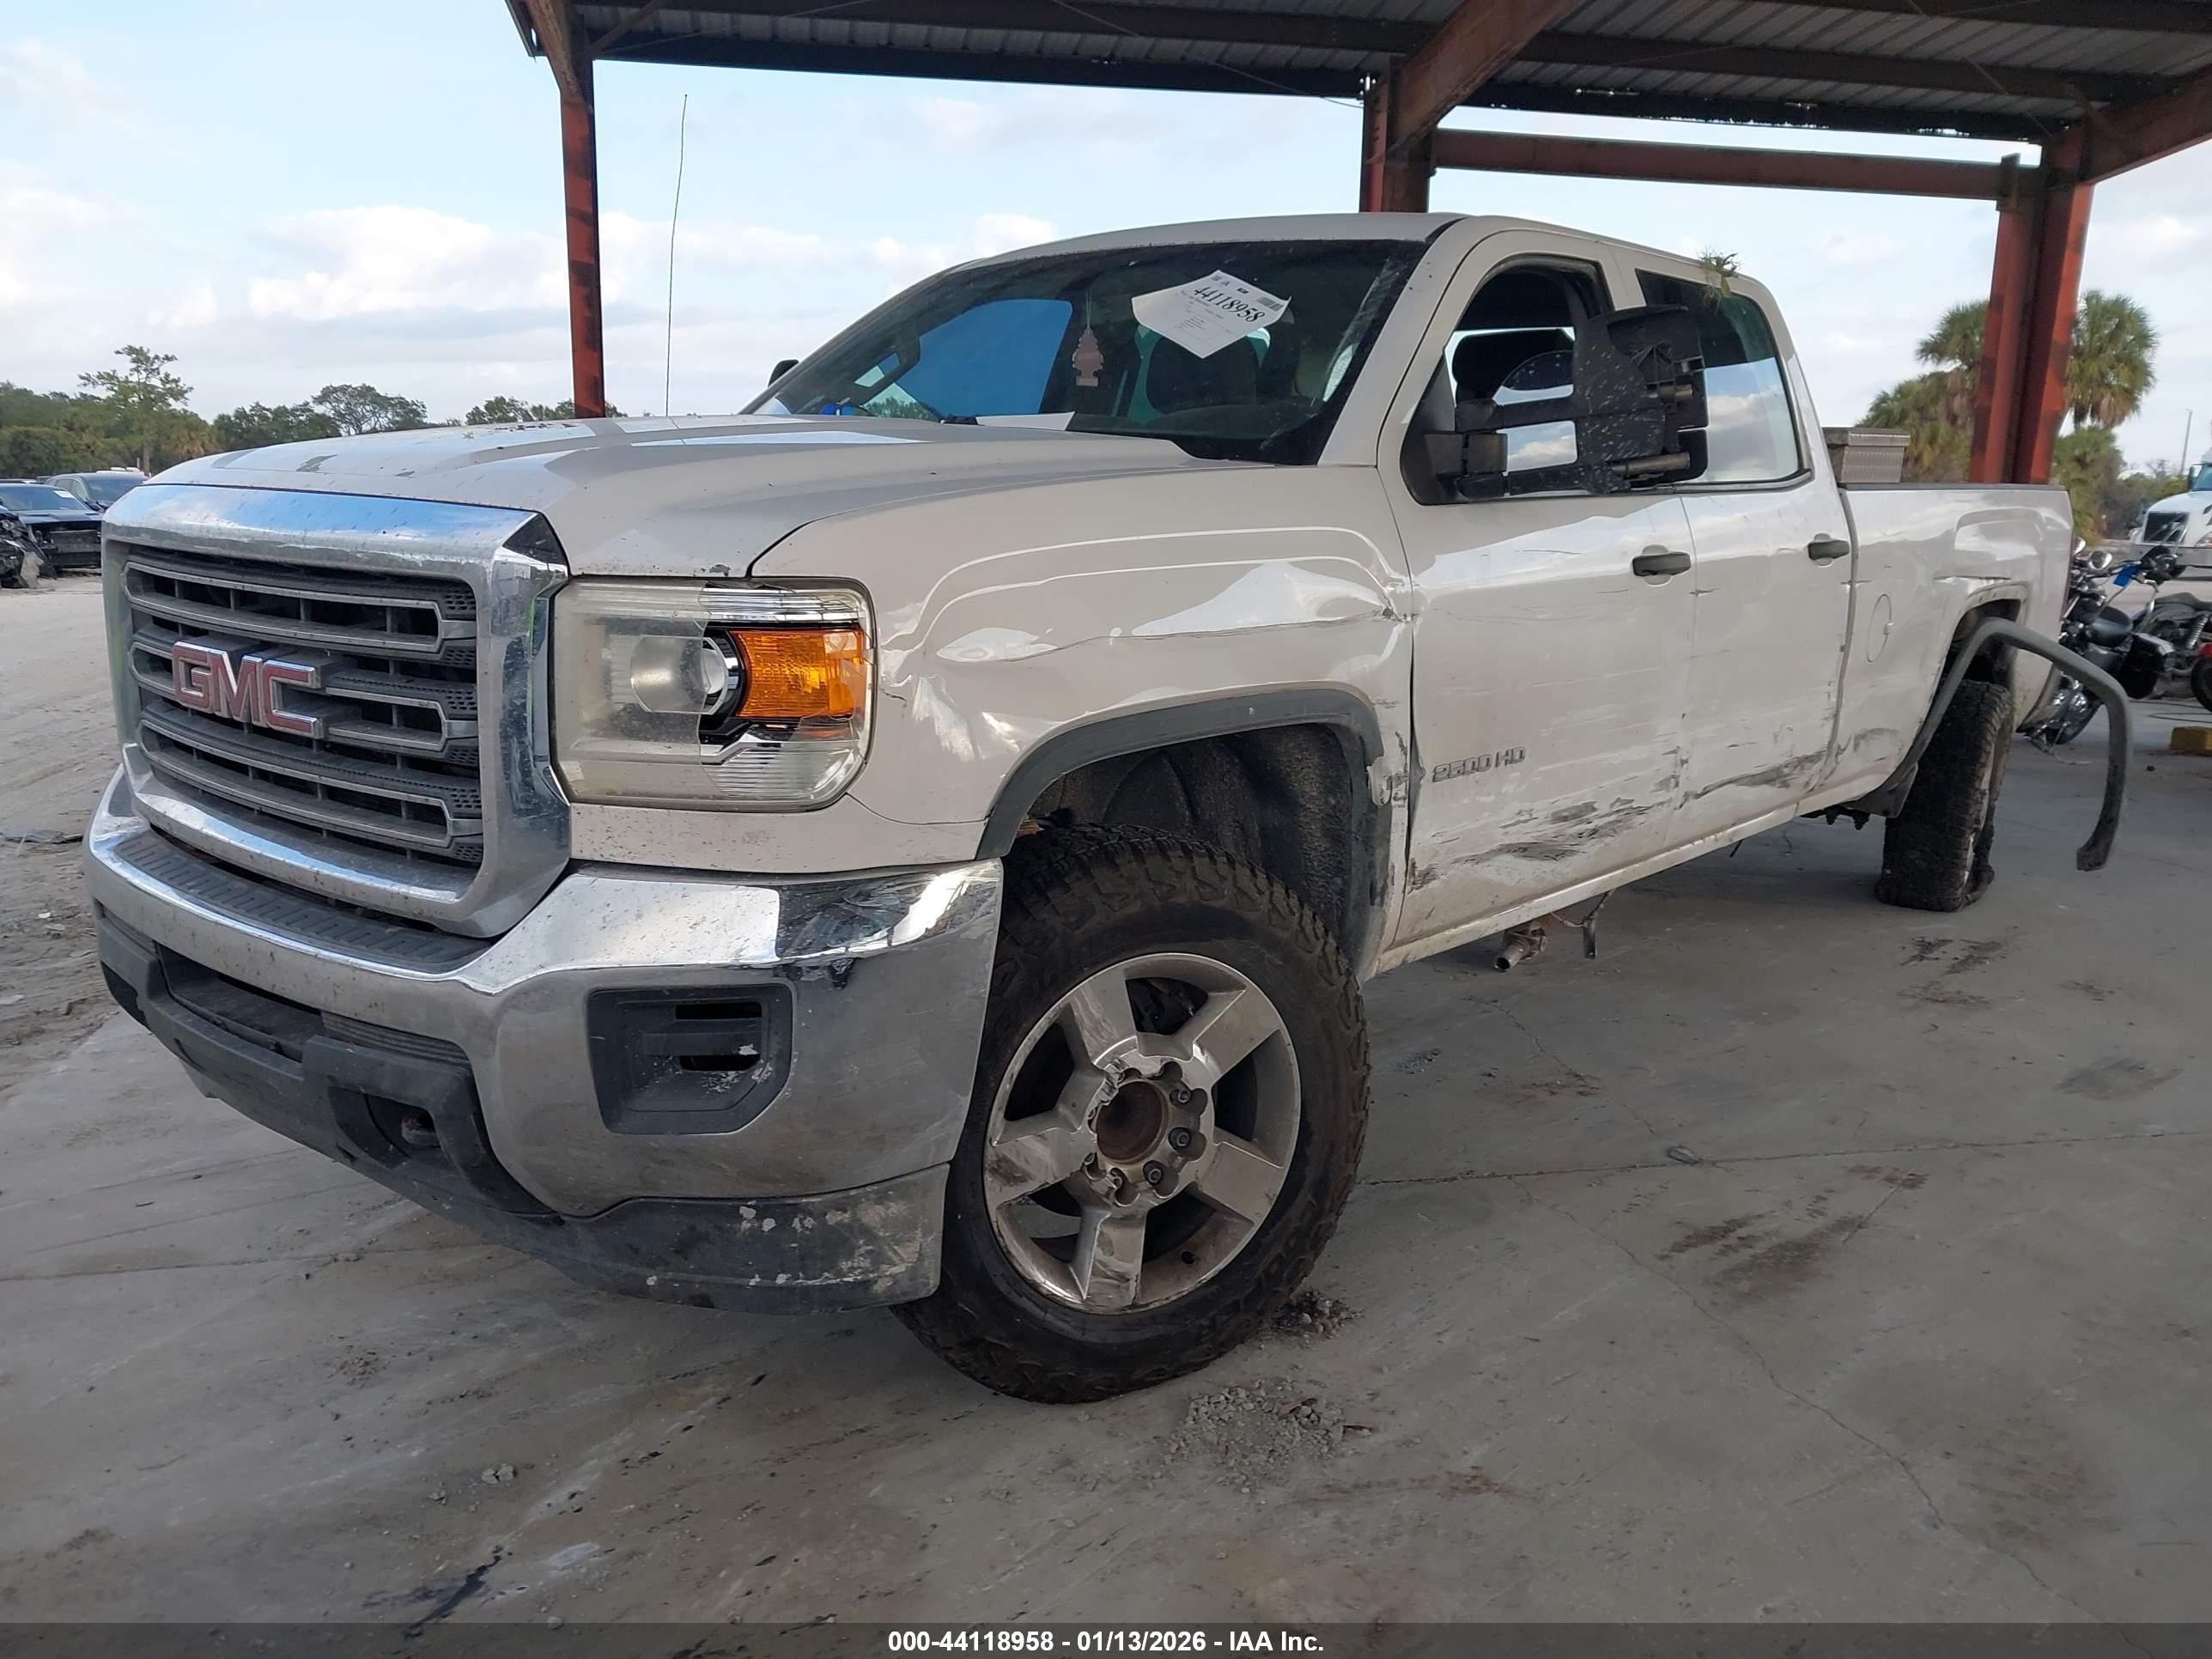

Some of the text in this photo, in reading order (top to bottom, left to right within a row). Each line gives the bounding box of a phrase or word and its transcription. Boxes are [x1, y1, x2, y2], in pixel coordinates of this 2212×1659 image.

[1194, 286, 1266, 323] 44118958
[172, 641, 324, 739] GMC
[1495, 746, 1526, 768] HD
